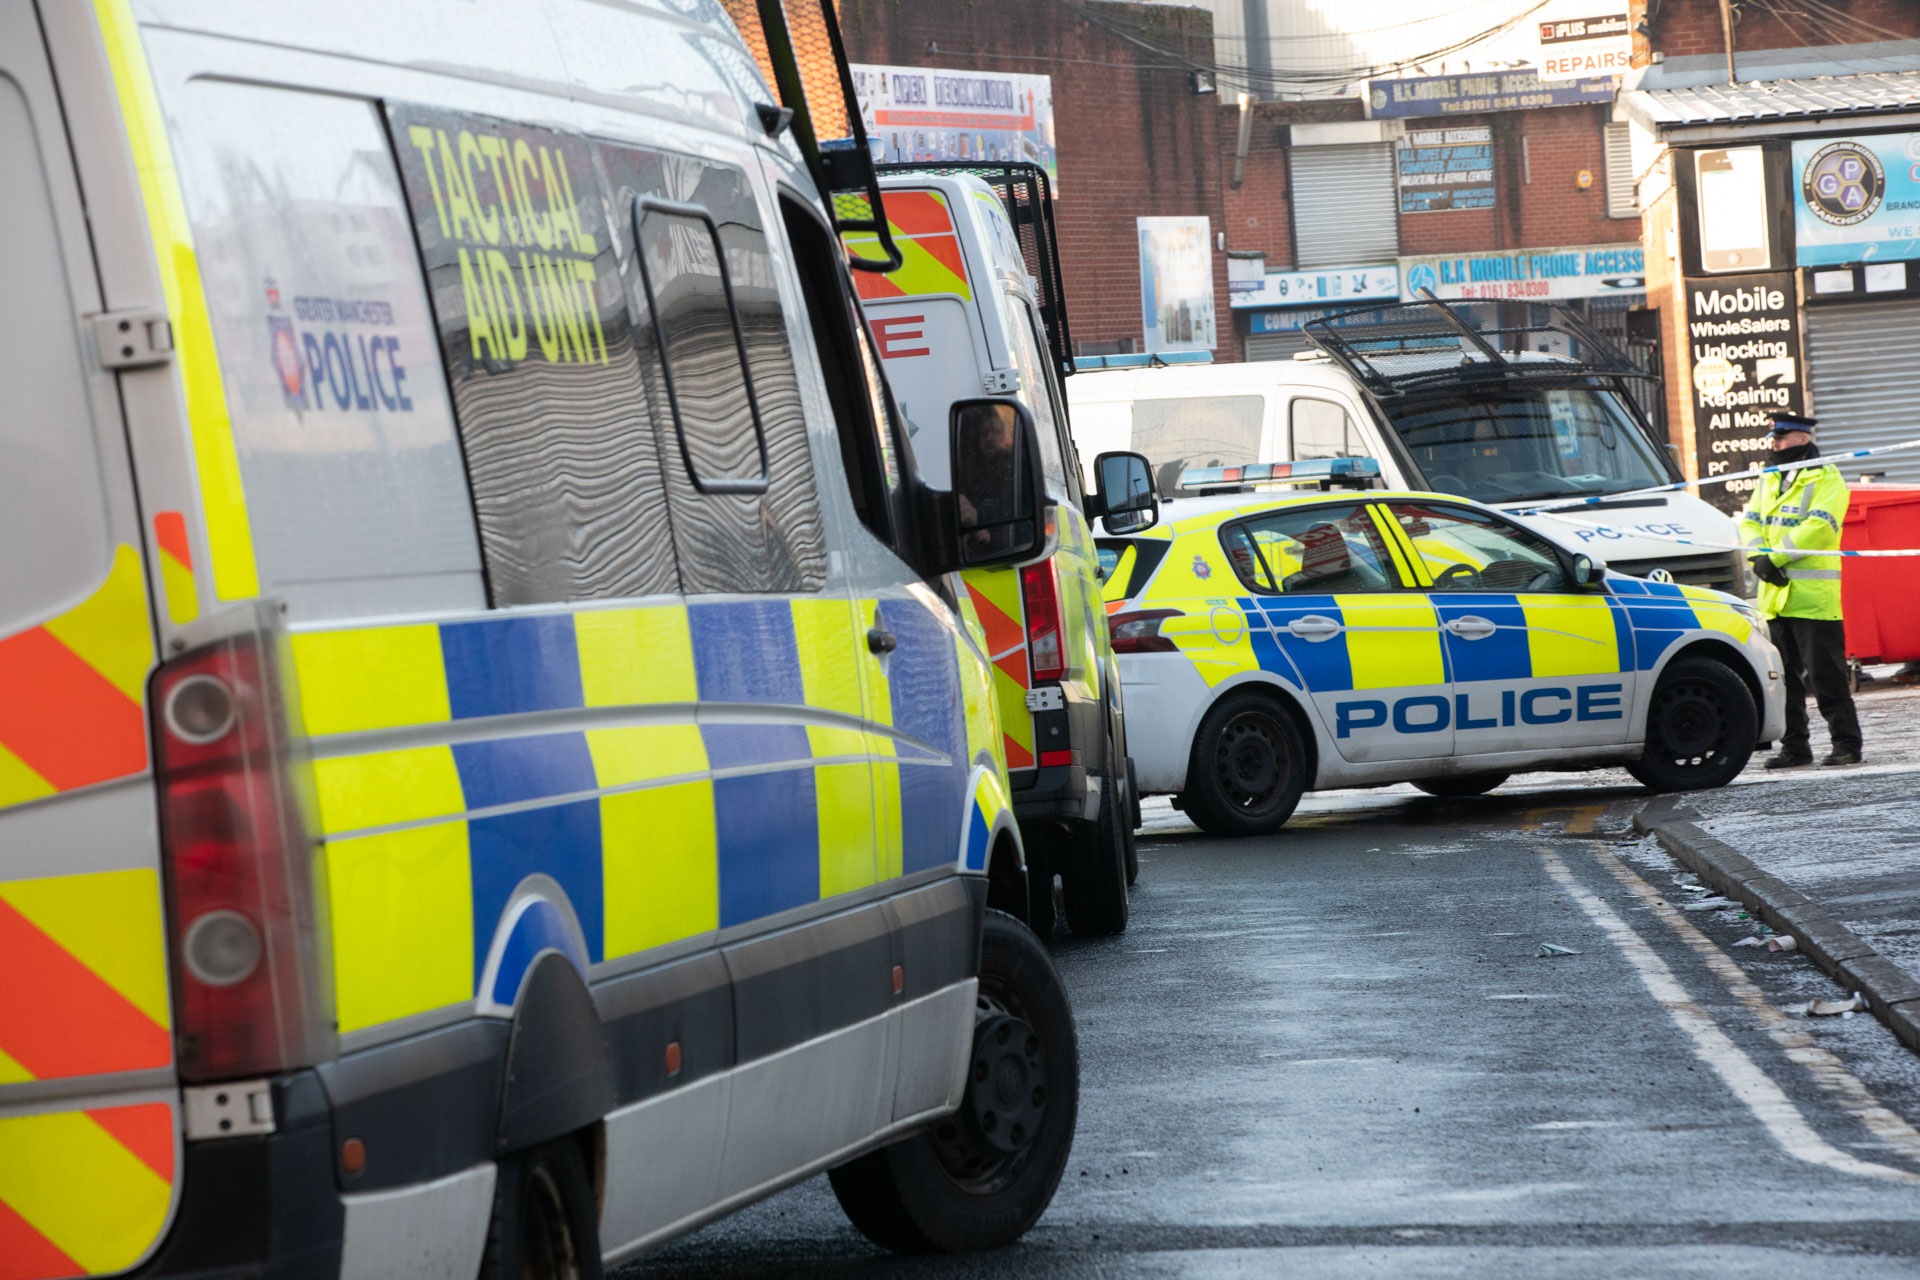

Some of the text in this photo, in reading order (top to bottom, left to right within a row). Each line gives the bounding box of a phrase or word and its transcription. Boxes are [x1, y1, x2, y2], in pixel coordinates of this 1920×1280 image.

[1587, 17, 1628, 34] mobiles
[1546, 51, 1628, 74] REPAIRS
[893, 74, 1014, 110] APEX TECHNOLOGY
[1460, 76, 1499, 97] PHONE
[1494, 96, 1517, 108] 834
[1520, 93, 1553, 106] 0300
[409, 125, 597, 254] TACTICAL
[1808, 196, 1882, 225] MANCHESTER
[1888, 226, 1912, 238] WE
[1469, 256, 1527, 282] MOBILE
[1530, 253, 1580, 278] PHONE
[1480, 284, 1503, 299] 0161
[1694, 286, 1785, 316] Mobile
[458, 247, 528, 361] AID
[519, 252, 609, 365] UNIT
[1690, 317, 1790, 338] WholeSalers
[1694, 339, 1787, 361] Unlocking
[302, 331, 414, 412] POLICE
[1732, 364, 1746, 382] &
[1699, 385, 1789, 409] Repairing
[1709, 412, 1730, 429] All
[1574, 523, 1693, 544] POICE
[1336, 683, 1623, 739] POLICE
